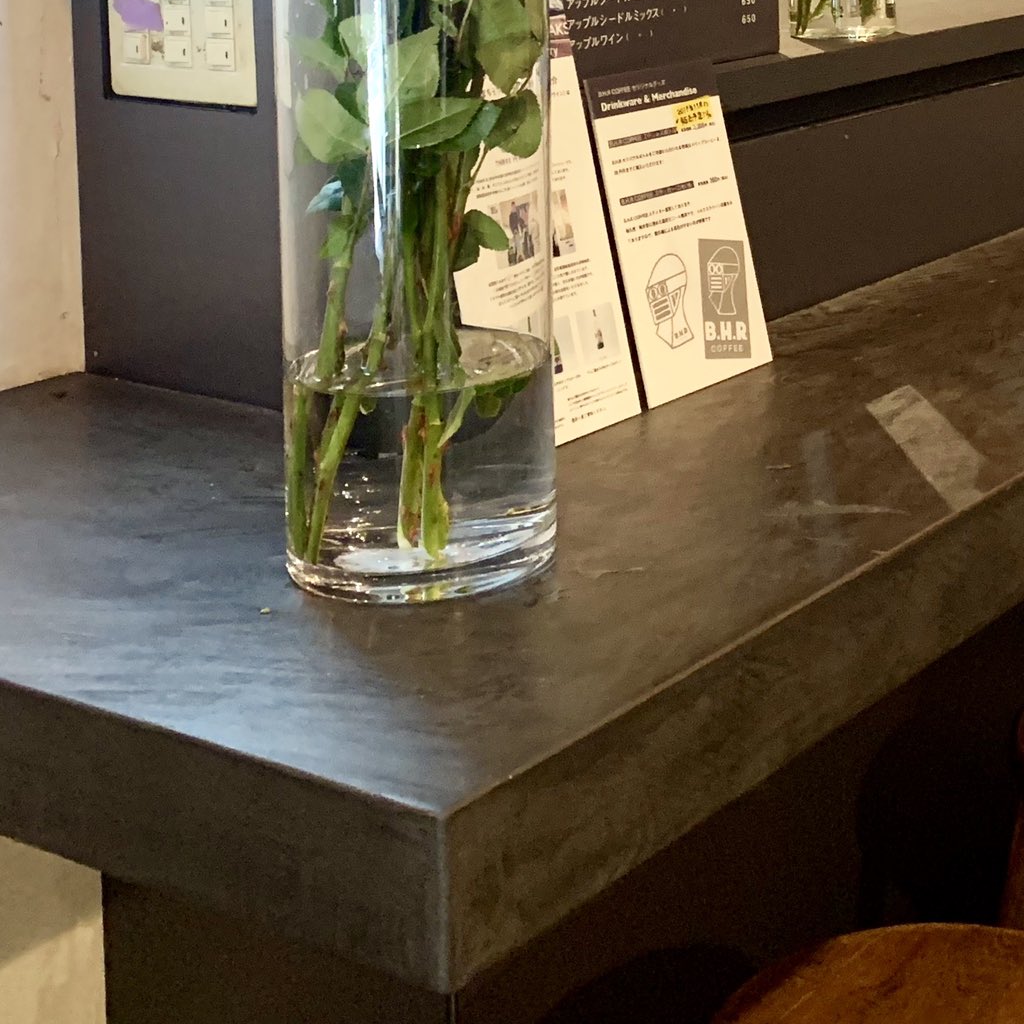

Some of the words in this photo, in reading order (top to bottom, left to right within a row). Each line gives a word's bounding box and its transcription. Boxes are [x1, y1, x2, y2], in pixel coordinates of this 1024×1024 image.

[741, 14, 756, 24] 650
[600, 96, 643, 112] Drinkware
[643, 94, 650, 104] &
[651, 86, 698, 102] Merchandise
[704, 320, 749, 342] B.H.R
[710, 343, 745, 353] COFFEE
